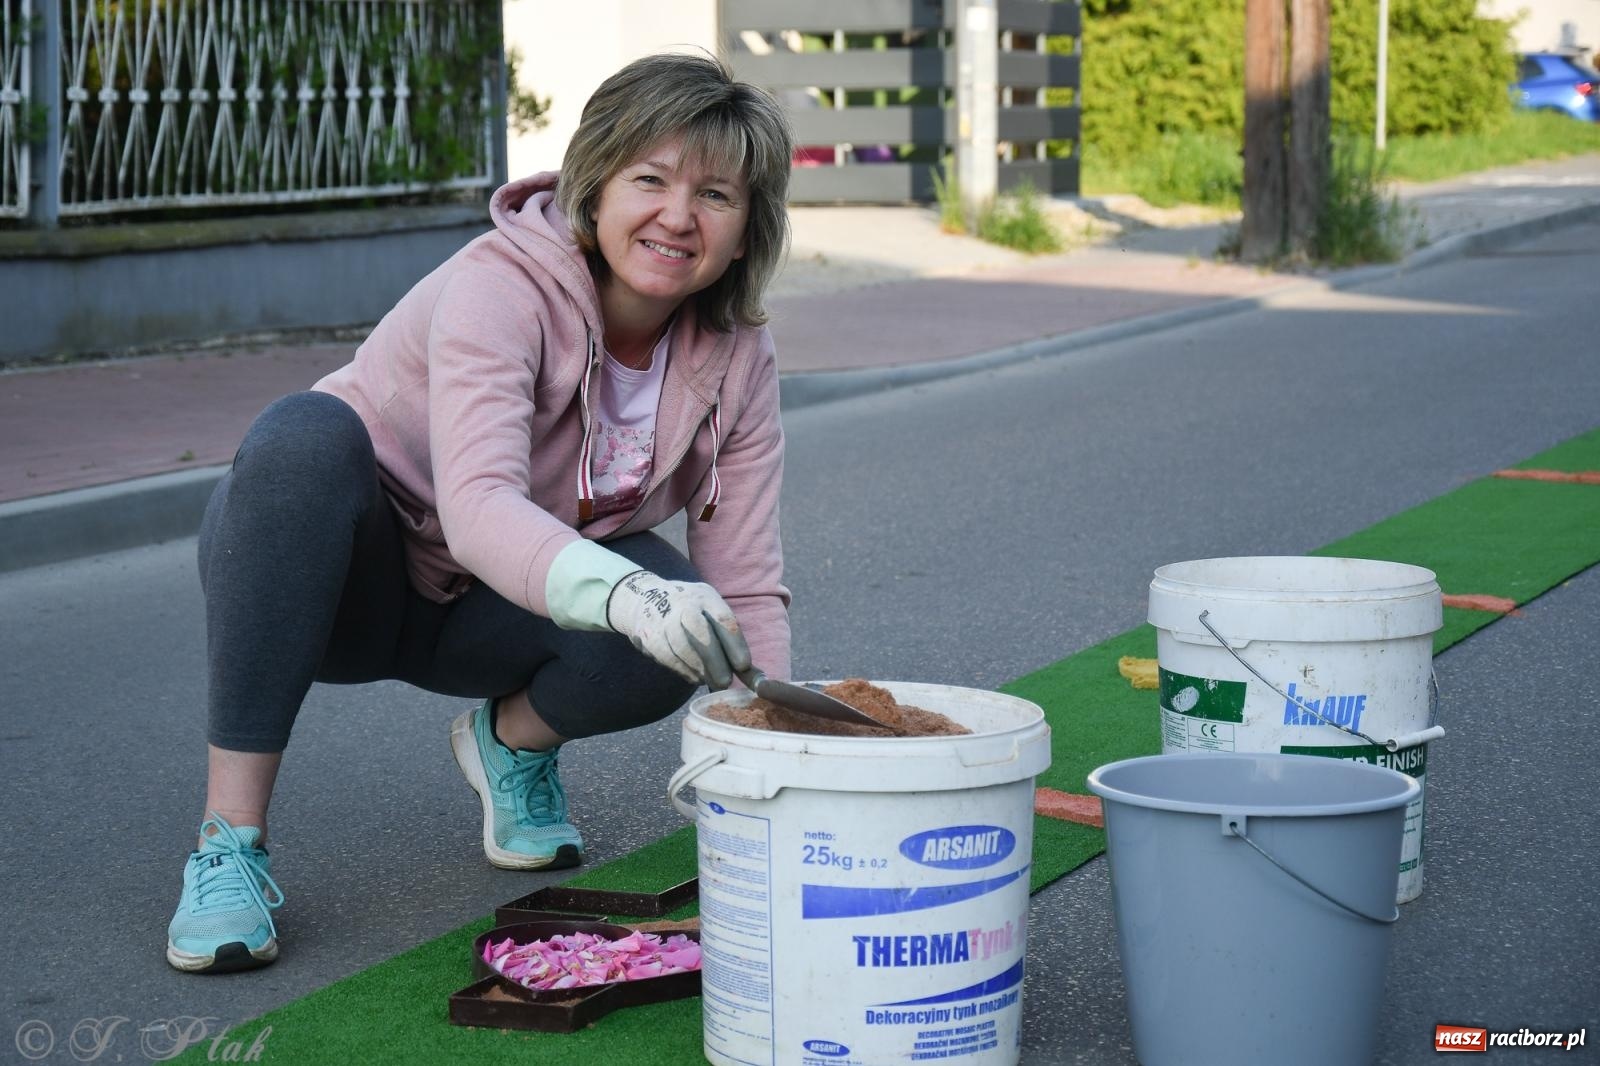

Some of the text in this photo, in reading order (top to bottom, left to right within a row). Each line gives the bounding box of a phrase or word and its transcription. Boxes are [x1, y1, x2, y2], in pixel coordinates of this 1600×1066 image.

[1377, 748, 1424, 771] FINISH
[804, 831, 836, 841] netto:
[922, 830, 1000, 862] ARSANIT
[802, 844, 853, 870] 25kg
[870, 859, 888, 868] 0,2
[866, 1008, 951, 1025] Dekoracyjny
[953, 1003, 977, 1020] tynk
[918, 1028, 954, 1039] DECORATIVE
[955, 1025, 976, 1036] MOSAIC
